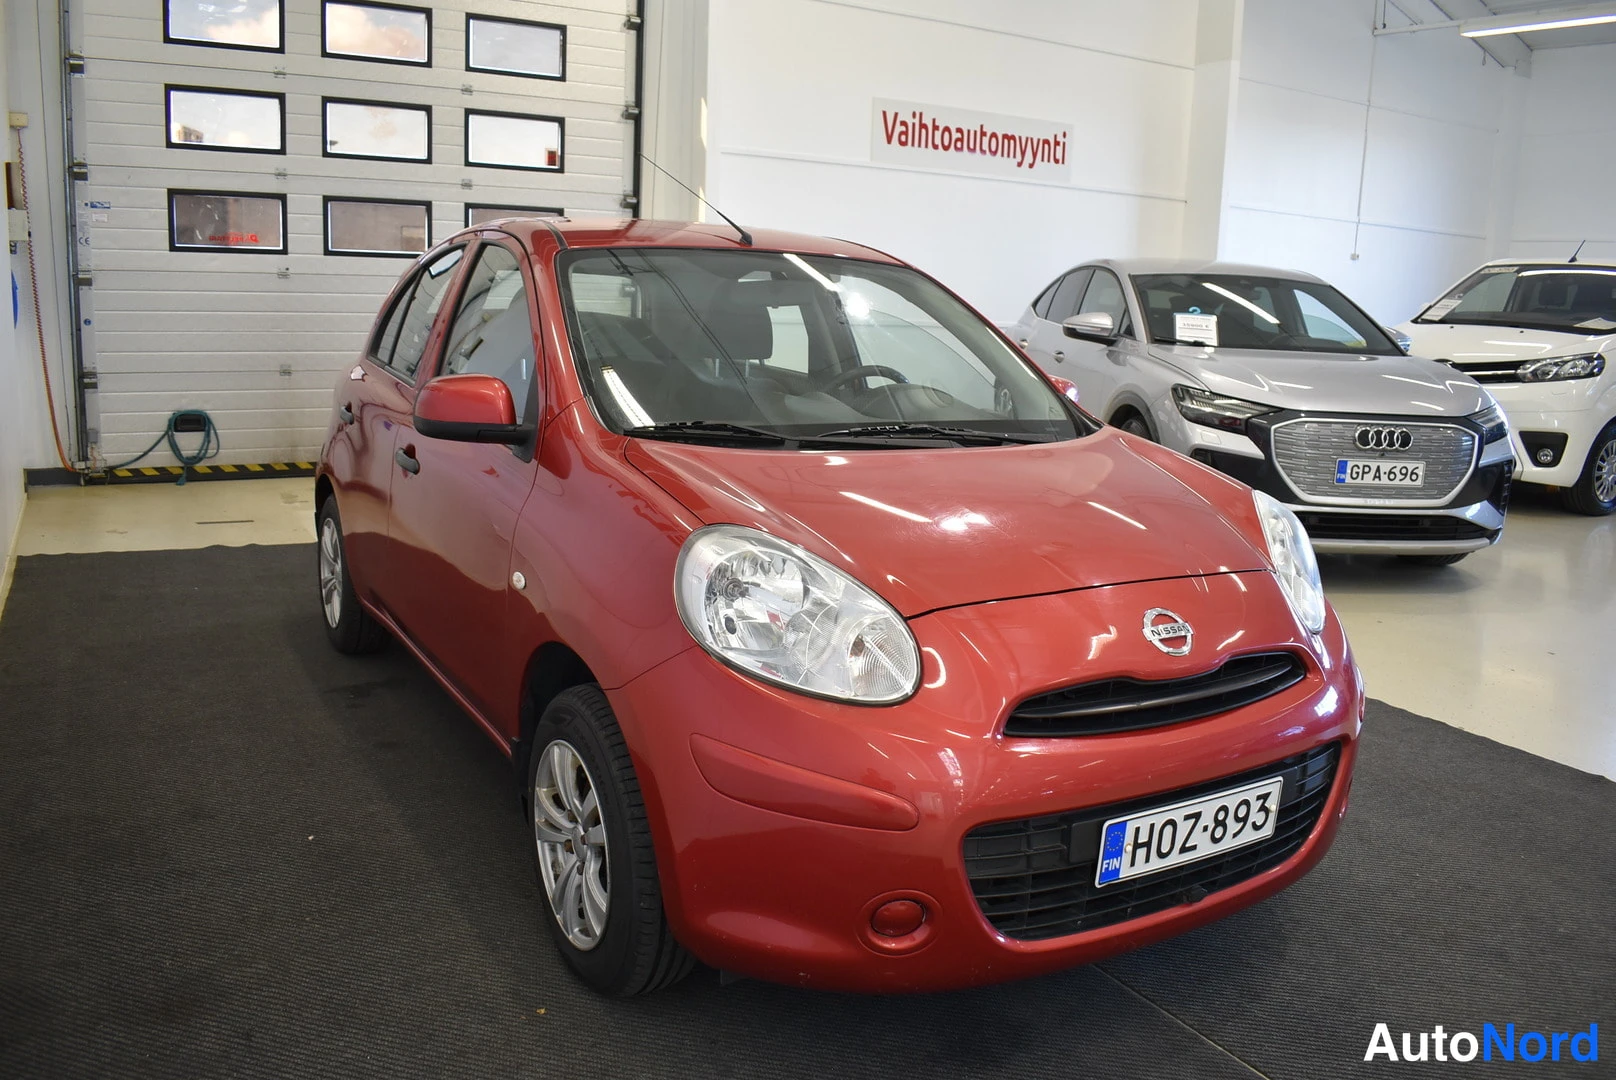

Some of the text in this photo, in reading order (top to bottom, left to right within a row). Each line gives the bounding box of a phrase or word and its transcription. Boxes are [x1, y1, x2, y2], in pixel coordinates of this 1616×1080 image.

[882, 110, 1067, 169] Vaihtoautomyynti
[1350, 464, 1419, 482] GPA-696
[1150, 625, 1190, 638] NISSAN
[1129, 791, 1273, 868] HOZ-893
[1102, 856, 1121, 873] FIN
